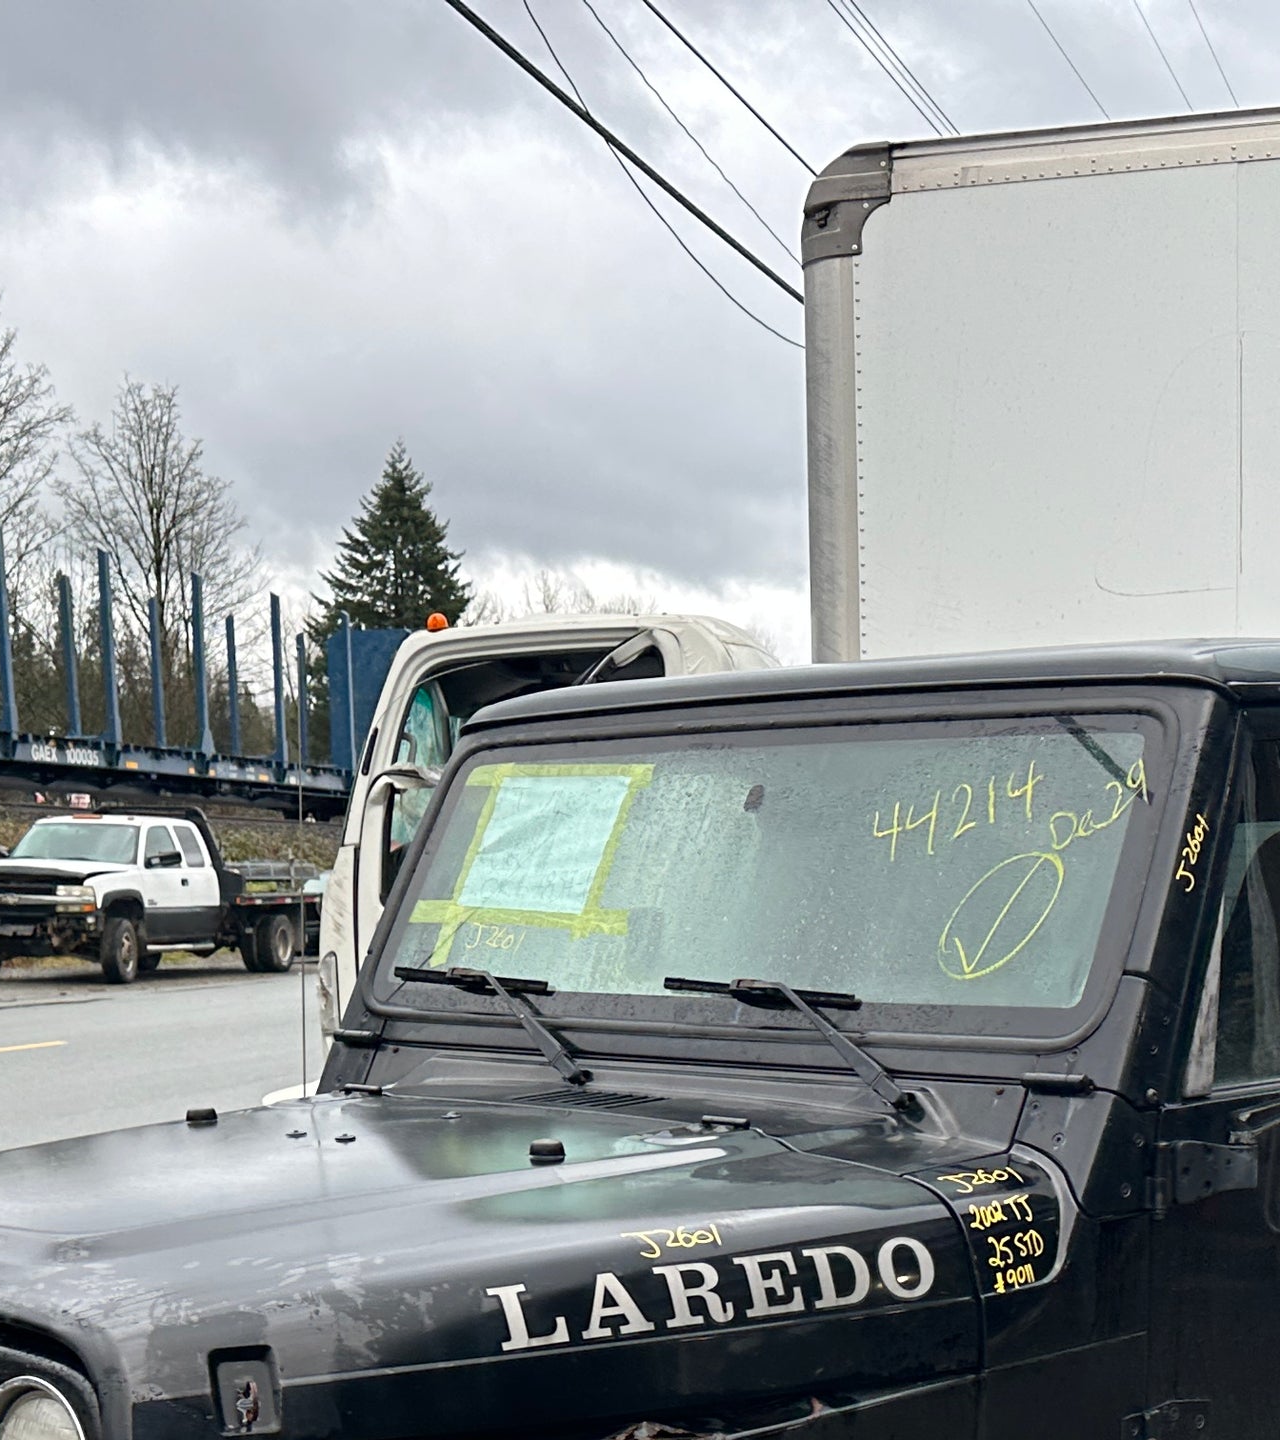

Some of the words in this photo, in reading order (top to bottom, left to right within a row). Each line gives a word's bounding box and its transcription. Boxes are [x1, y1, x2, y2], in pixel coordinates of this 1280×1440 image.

[31, 743, 58, 762] GAEX
[65, 747, 99, 766] 100035
[873, 760, 1044, 861] 44214
[1175, 813, 1210, 892] J2601
[937, 1166, 1024, 1193] J2601
[968, 1200, 1008, 1230] 2002
[1004, 1194, 1033, 1222] TJ
[620, 1223, 722, 1259] J2601
[1014, 1229, 1044, 1257] STD
[486, 1237, 934, 1352] LAREDO
